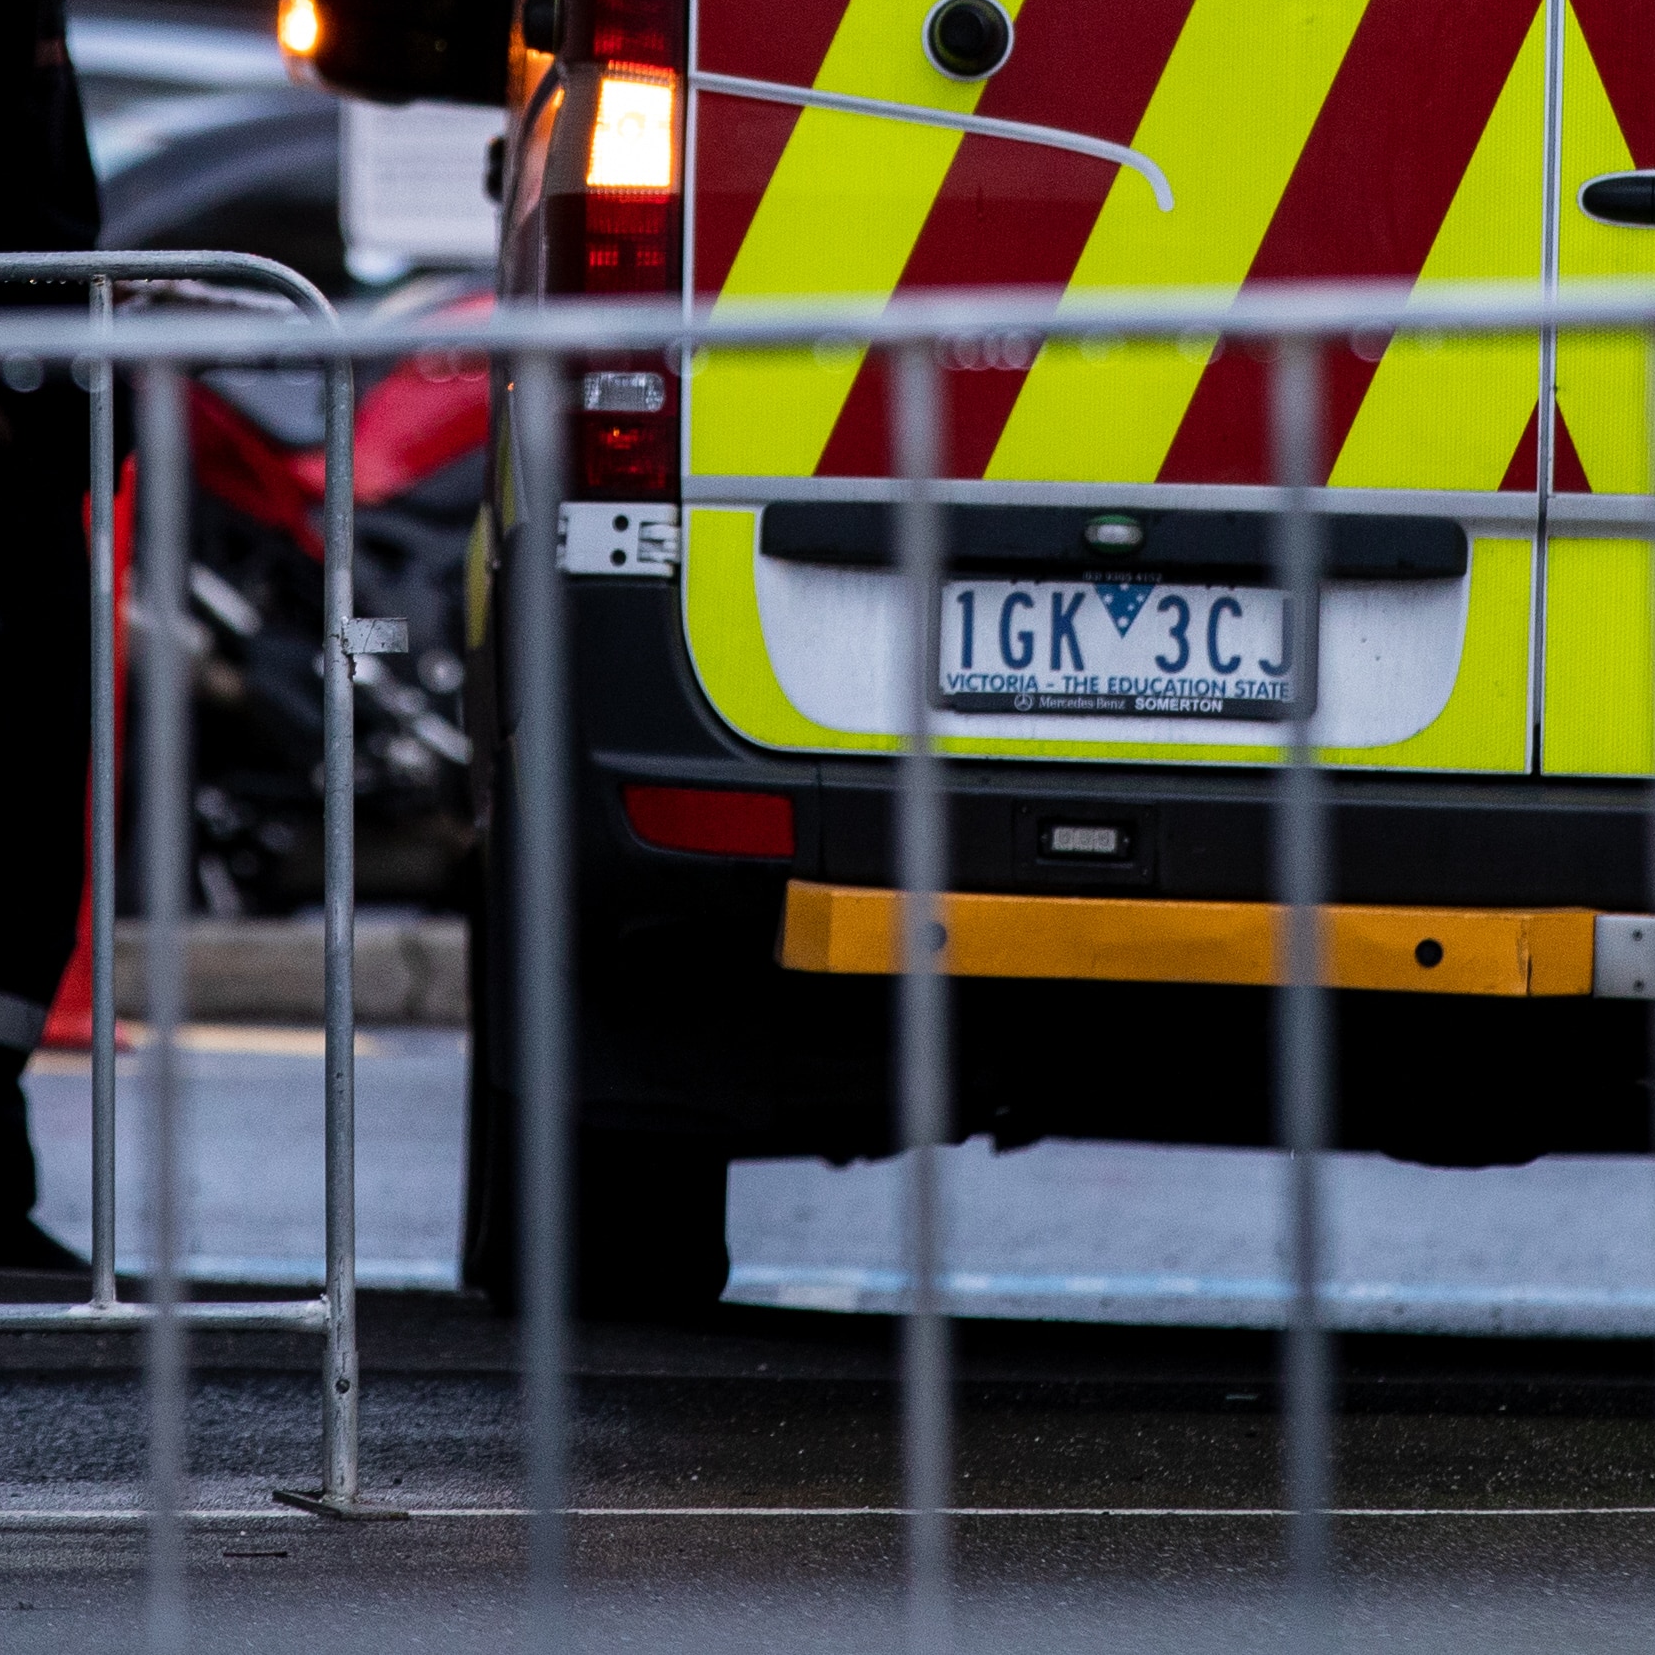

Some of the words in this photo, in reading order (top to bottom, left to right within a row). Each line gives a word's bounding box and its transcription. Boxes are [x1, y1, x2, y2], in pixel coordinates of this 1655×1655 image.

[956, 590, 1086, 672] 1GK
[946, 673, 1039, 694] VICTORIA
[1062, 674, 1101, 694] THE
[1107, 676, 1227, 698] EDUCATION
[1233, 679, 1291, 700] STATE
[1134, 697, 1224, 713] SOMERTON
